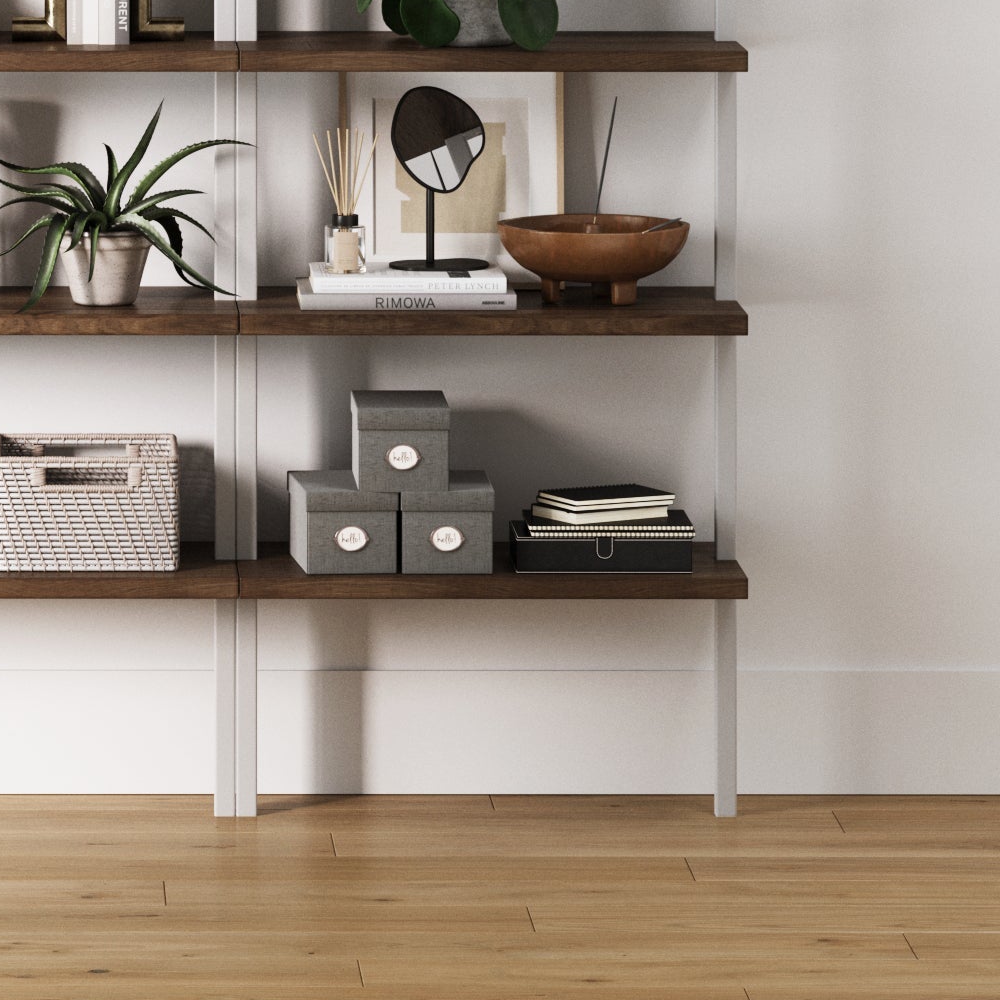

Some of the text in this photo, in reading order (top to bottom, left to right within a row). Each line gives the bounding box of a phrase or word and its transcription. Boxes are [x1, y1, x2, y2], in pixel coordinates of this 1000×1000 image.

[428, 282, 461, 290] PETER
[465, 282, 499, 290] LYNCH
[375, 297, 436, 309] RIMOWA
